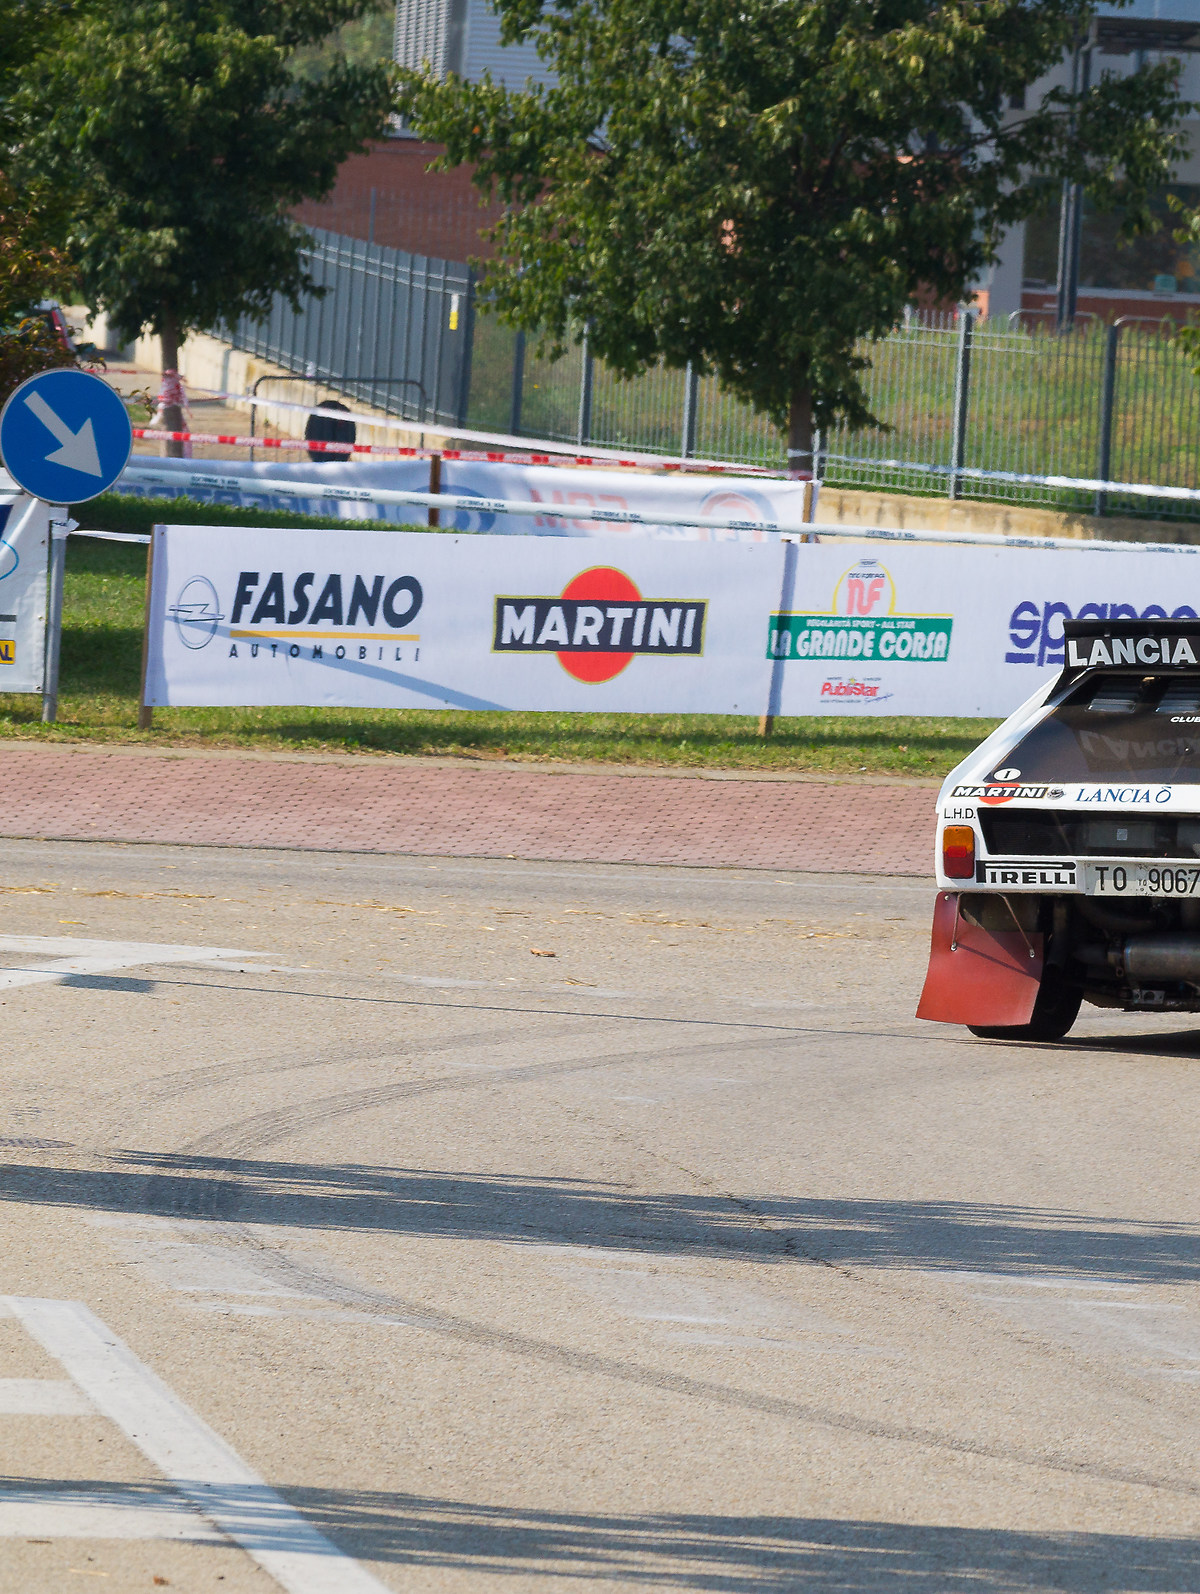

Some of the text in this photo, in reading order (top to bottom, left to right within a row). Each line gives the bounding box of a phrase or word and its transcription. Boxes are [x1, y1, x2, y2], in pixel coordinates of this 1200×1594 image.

[231, 572, 423, 627] FASANO
[501, 604, 696, 648] MARTINI
[229, 643, 421, 662] AUTOMOBILI
[771, 630, 948, 659] LA GRANDE CORSA
[1067, 638, 1198, 668] LANCIA
[953, 786, 1048, 799] MARTINI
[1075, 788, 1150, 803] LANCIA
[944, 808, 977, 820] L.H.D.
[976, 860, 1077, 885] PIRELLI
[1095, 866, 1127, 892] TO
